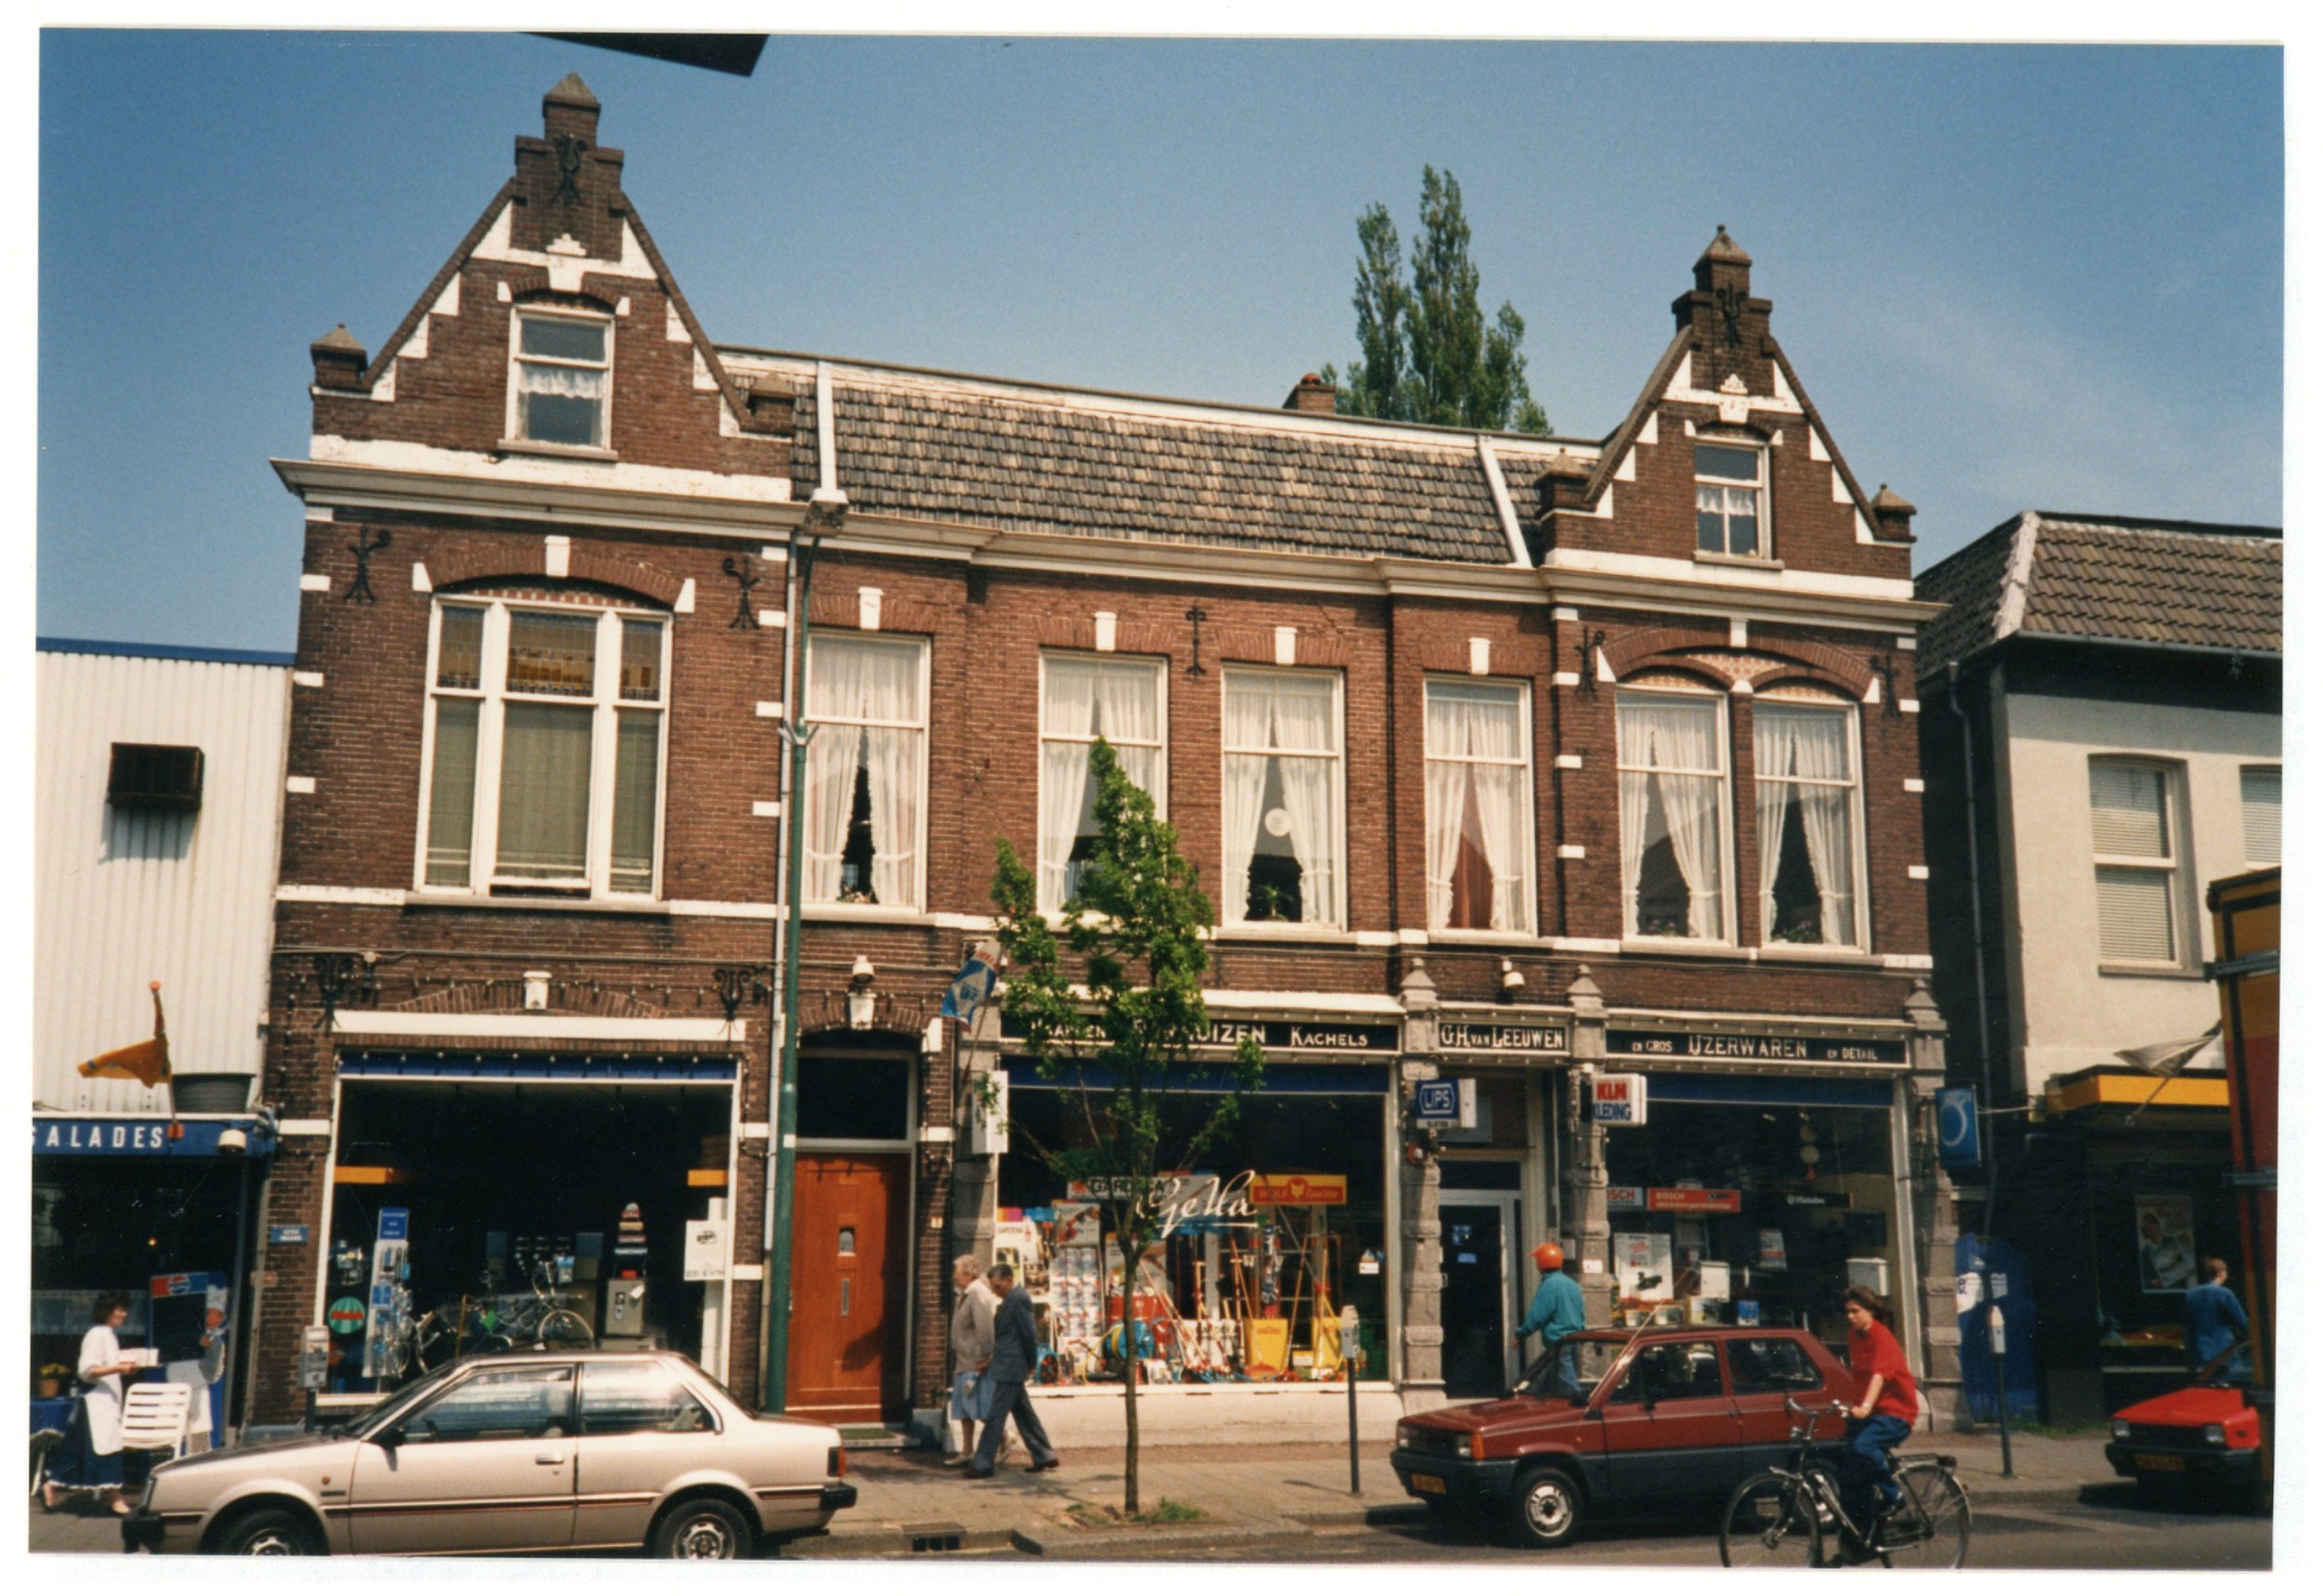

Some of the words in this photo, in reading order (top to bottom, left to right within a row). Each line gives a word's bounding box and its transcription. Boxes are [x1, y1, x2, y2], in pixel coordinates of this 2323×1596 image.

[1291, 1027, 1368, 1046] KACHELS
[1491, 1027, 1563, 1048] LEEUWEN
[1645, 1040, 1673, 1053] GROS
[1842, 1047, 1878, 1060] DETAIL
[1424, 1090, 1450, 1107] LIPS
[1596, 1081, 1627, 1101] KLM
[1606, 1188, 1635, 1200] OSCH
[1655, 1191, 1685, 1200] BOSCH
